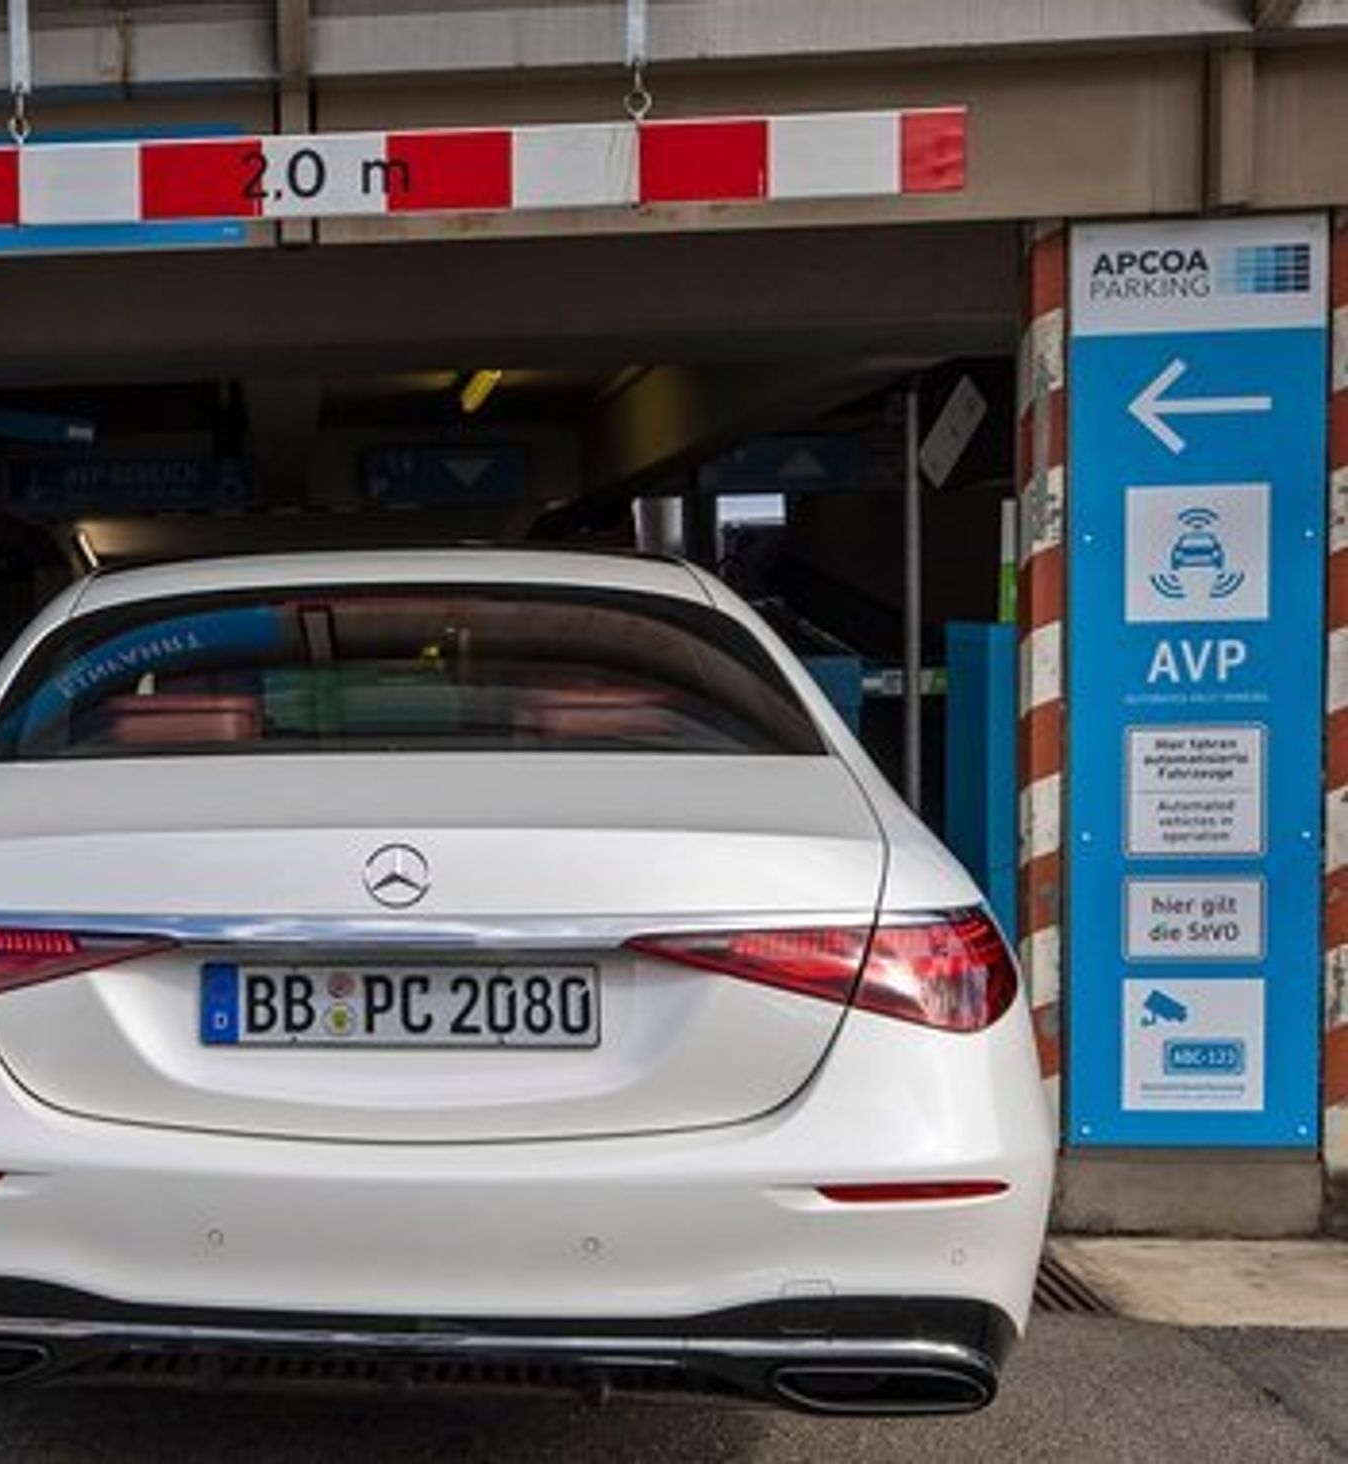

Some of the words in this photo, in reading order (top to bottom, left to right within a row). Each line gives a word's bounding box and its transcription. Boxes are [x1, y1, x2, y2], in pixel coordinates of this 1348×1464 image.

[361, 158, 410, 195] m
[1093, 249, 1209, 275] APCOA
[1090, 274, 1210, 299] PARKING
[1147, 639, 1247, 683] AVP
[1152, 897, 1194, 915] hier
[1201, 897, 1238, 918] gilt
[1149, 922, 1183, 942] die
[1188, 920, 1240, 942] StVO
[245, 974, 317, 1034] BB
[363, 974, 434, 1034] PC
[449, 975, 592, 1034] 2080
[213, 1010, 229, 1030] D
